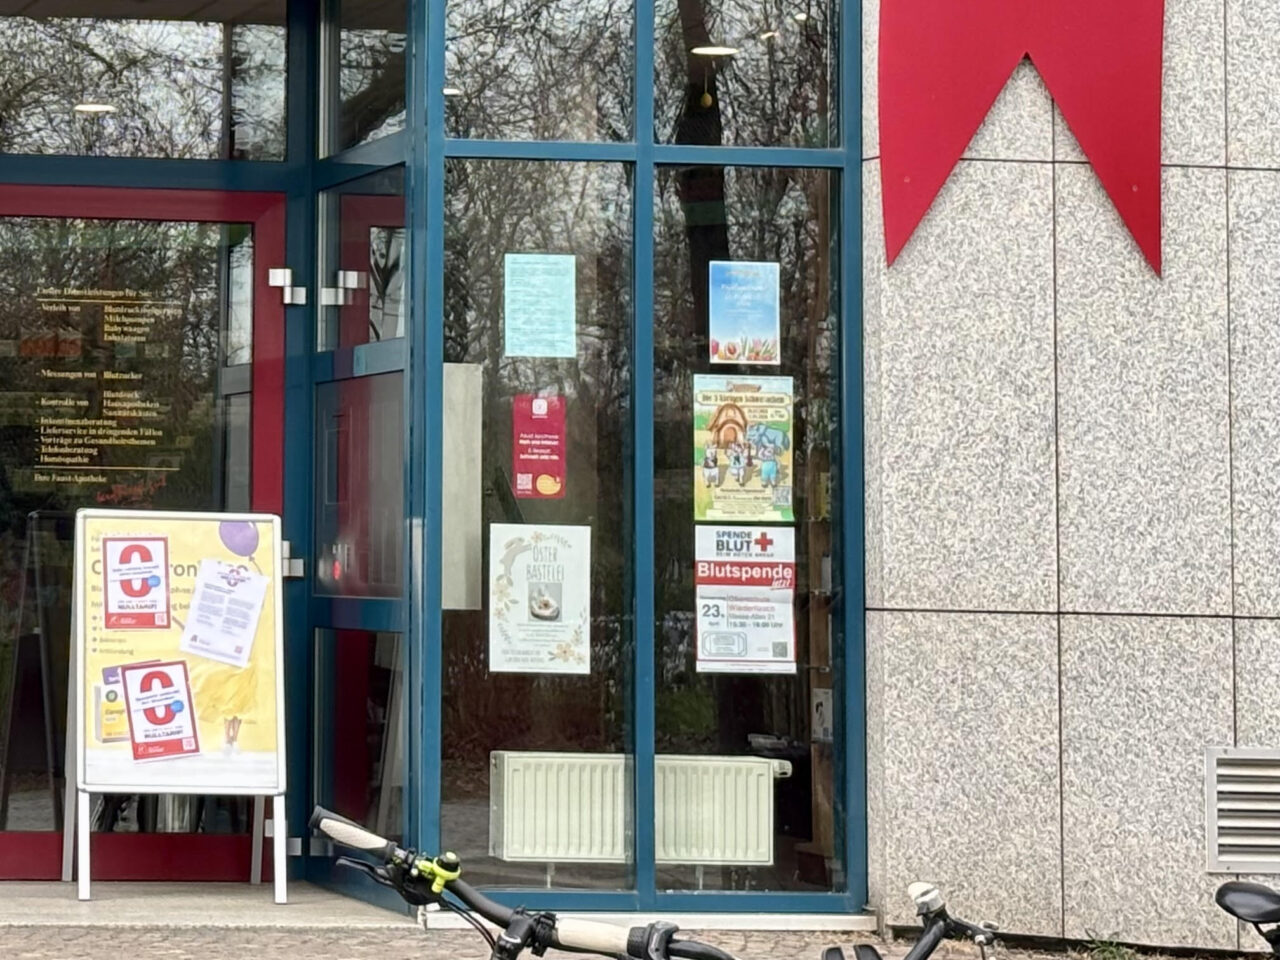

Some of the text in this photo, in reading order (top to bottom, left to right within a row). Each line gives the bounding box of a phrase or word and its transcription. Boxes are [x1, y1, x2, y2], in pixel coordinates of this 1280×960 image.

[715, 530, 753, 540] SPENDE
[716, 540, 753, 553] BLUT
[526, 564, 565, 582] BASTELEI
[697, 562, 793, 581] Blutspende
[701, 603, 725, 619] 23.
